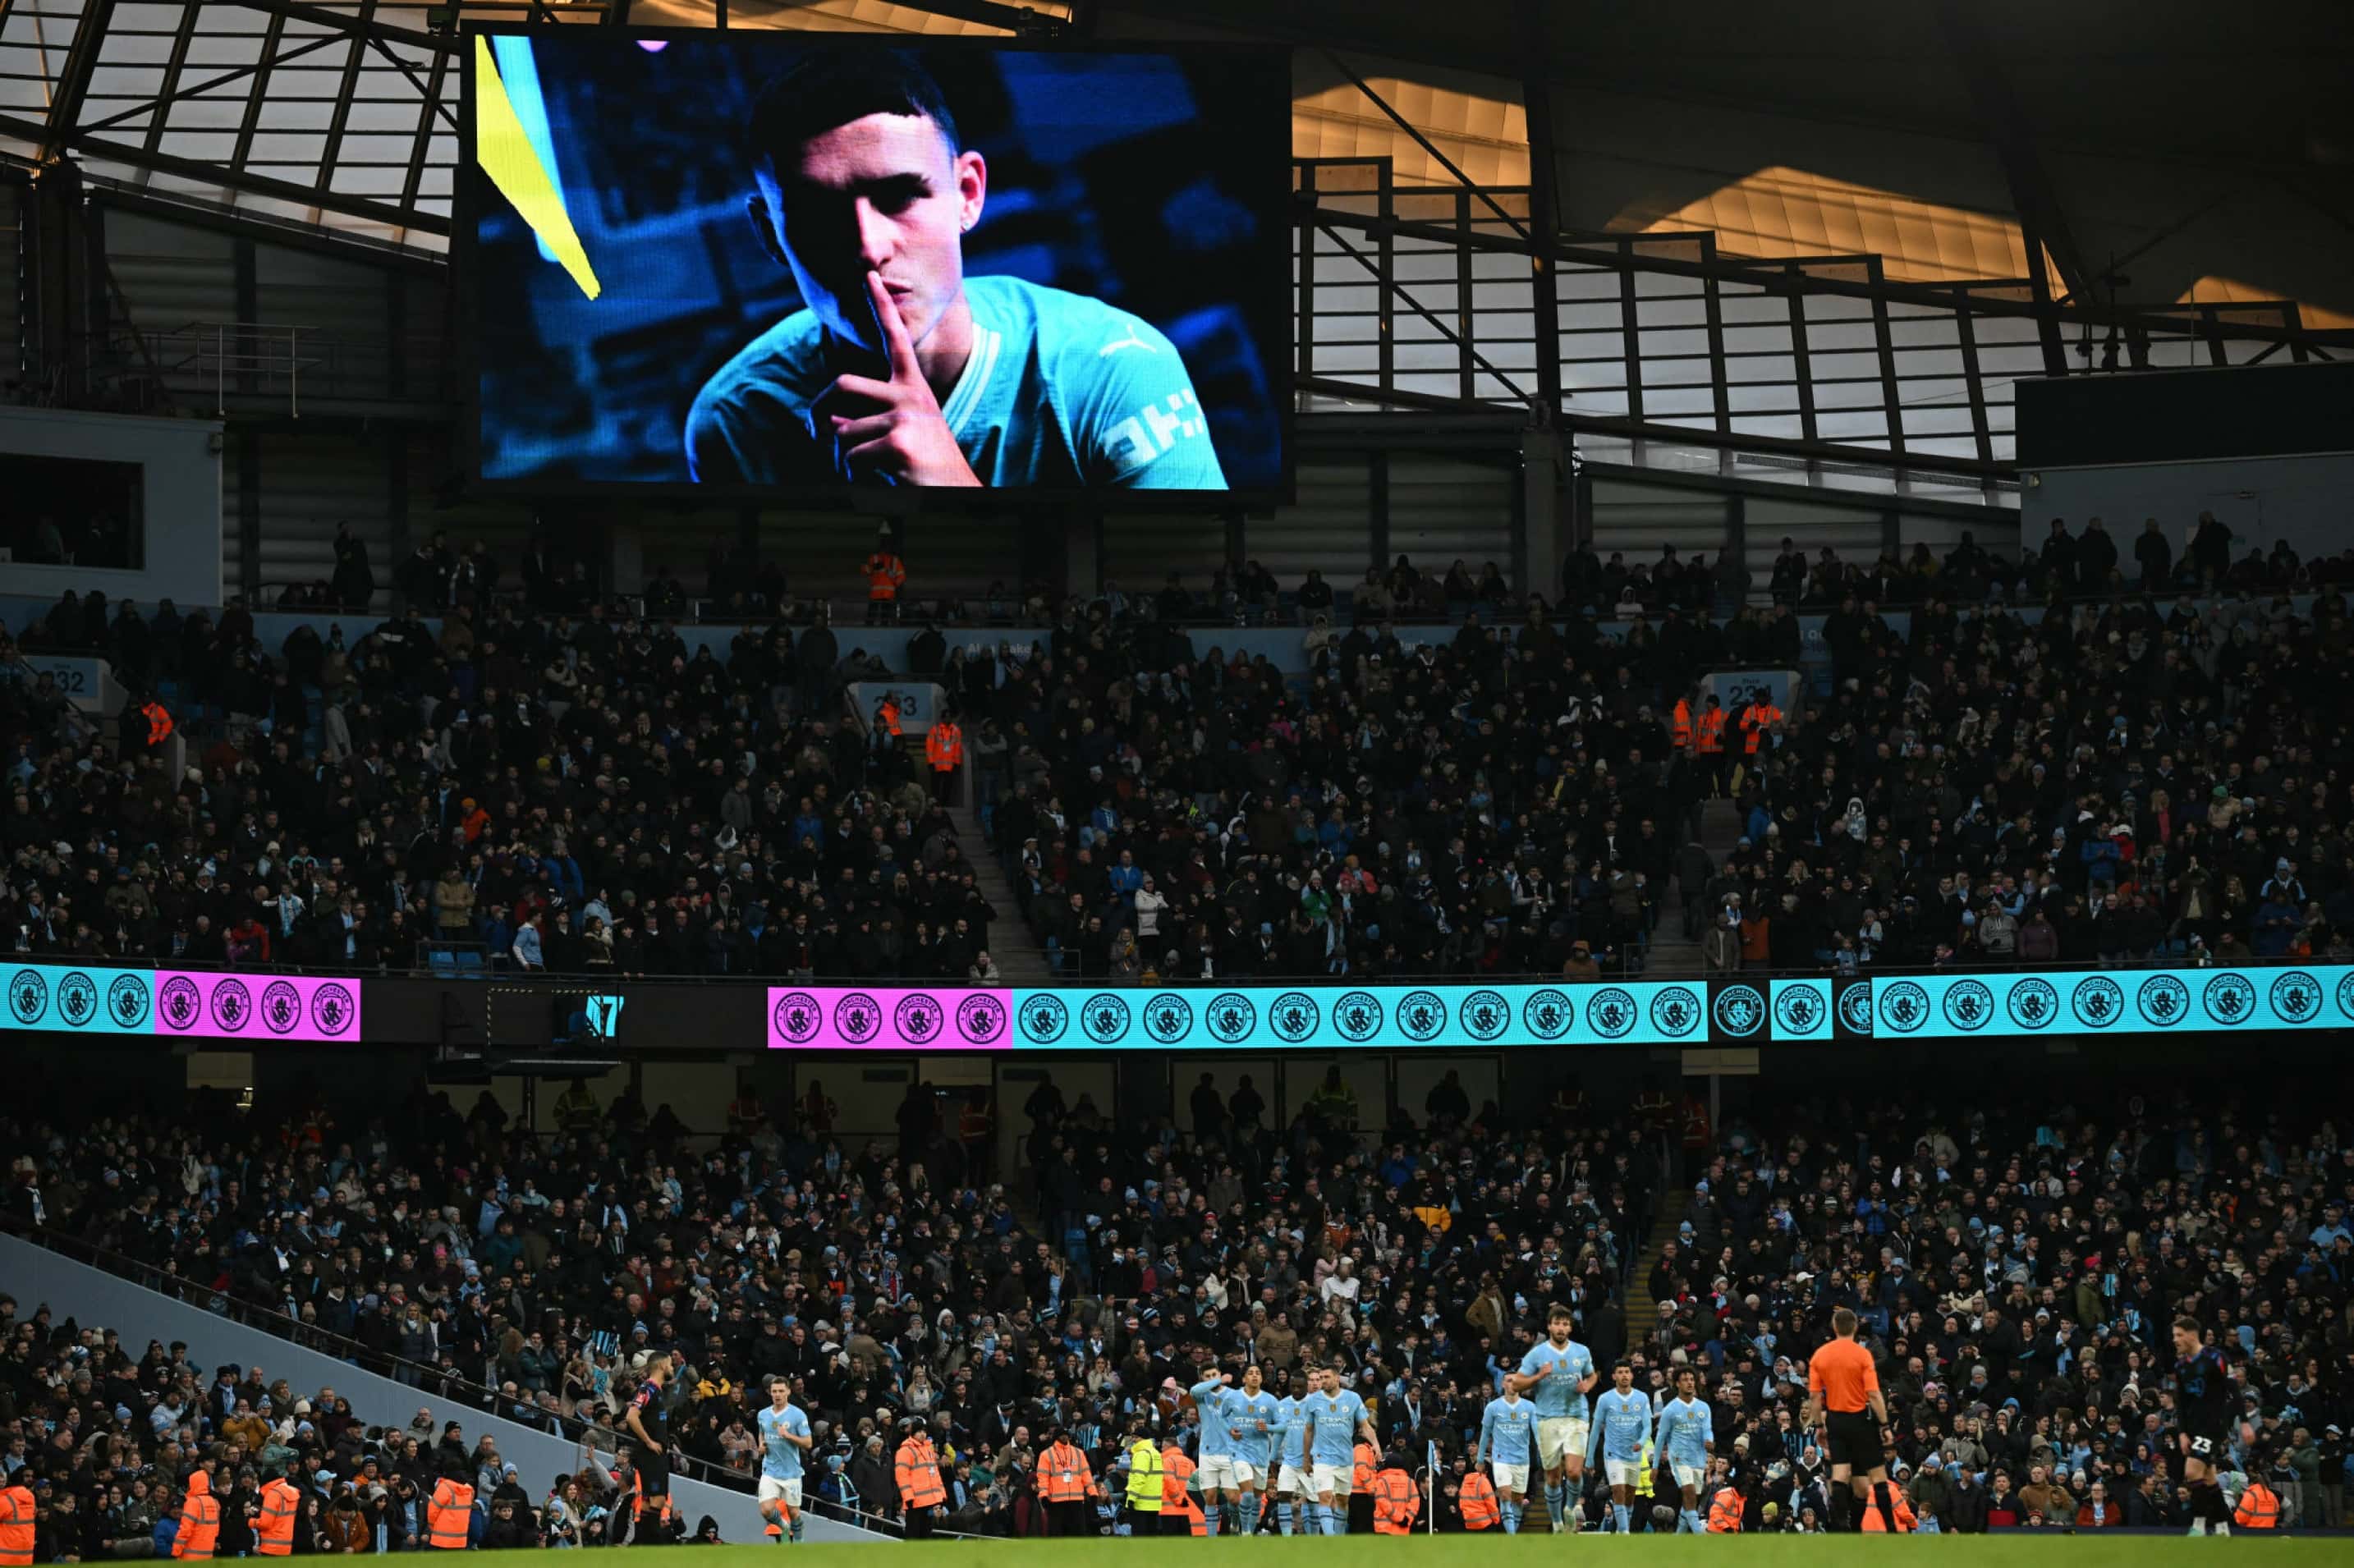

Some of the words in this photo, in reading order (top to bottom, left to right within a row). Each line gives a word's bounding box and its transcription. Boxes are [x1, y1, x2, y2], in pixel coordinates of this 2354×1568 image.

[2013, 983, 2053, 997] MANCHESTER
[2078, 981, 2118, 996] MANCHESTER
[2144, 979, 2184, 994] MANCHESTER
[2209, 978, 2251, 993] MANCHESTER
[2276, 976, 2317, 991] MANCHESTER
[1720, 990, 1760, 1004] MANCHESTER
[1781, 989, 1819, 1003] MANCHESTER
[1886, 986, 1924, 1001] MANCHESTER
[1949, 984, 1989, 999] MANCHESTER
[780, 997, 816, 1011] MANCHESTER
[839, 997, 876, 1012] MANCHESTER
[900, 998, 938, 1012] MANCHESTER
[962, 998, 1000, 1012] MANCHESTER
[1025, 998, 1062, 1012] MANCHESTER
[1087, 998, 1125, 1012] MANCHESTER
[1149, 998, 1187, 1012] MANCHESTER
[1212, 997, 1250, 1011] MANCHESTER
[1275, 997, 1314, 1011] MANCHESTER
[1339, 996, 1377, 1011] MANCHESTER
[1403, 996, 1441, 1010] MANCHESTER
[1466, 995, 1505, 1009] MANCHESTER
[1530, 993, 1568, 1008] MANCHESTER
[1593, 993, 1631, 1006] MANCHESTER
[1656, 992, 1696, 1006] MANCHESTER
[2191, 1435, 2213, 1453] 23
